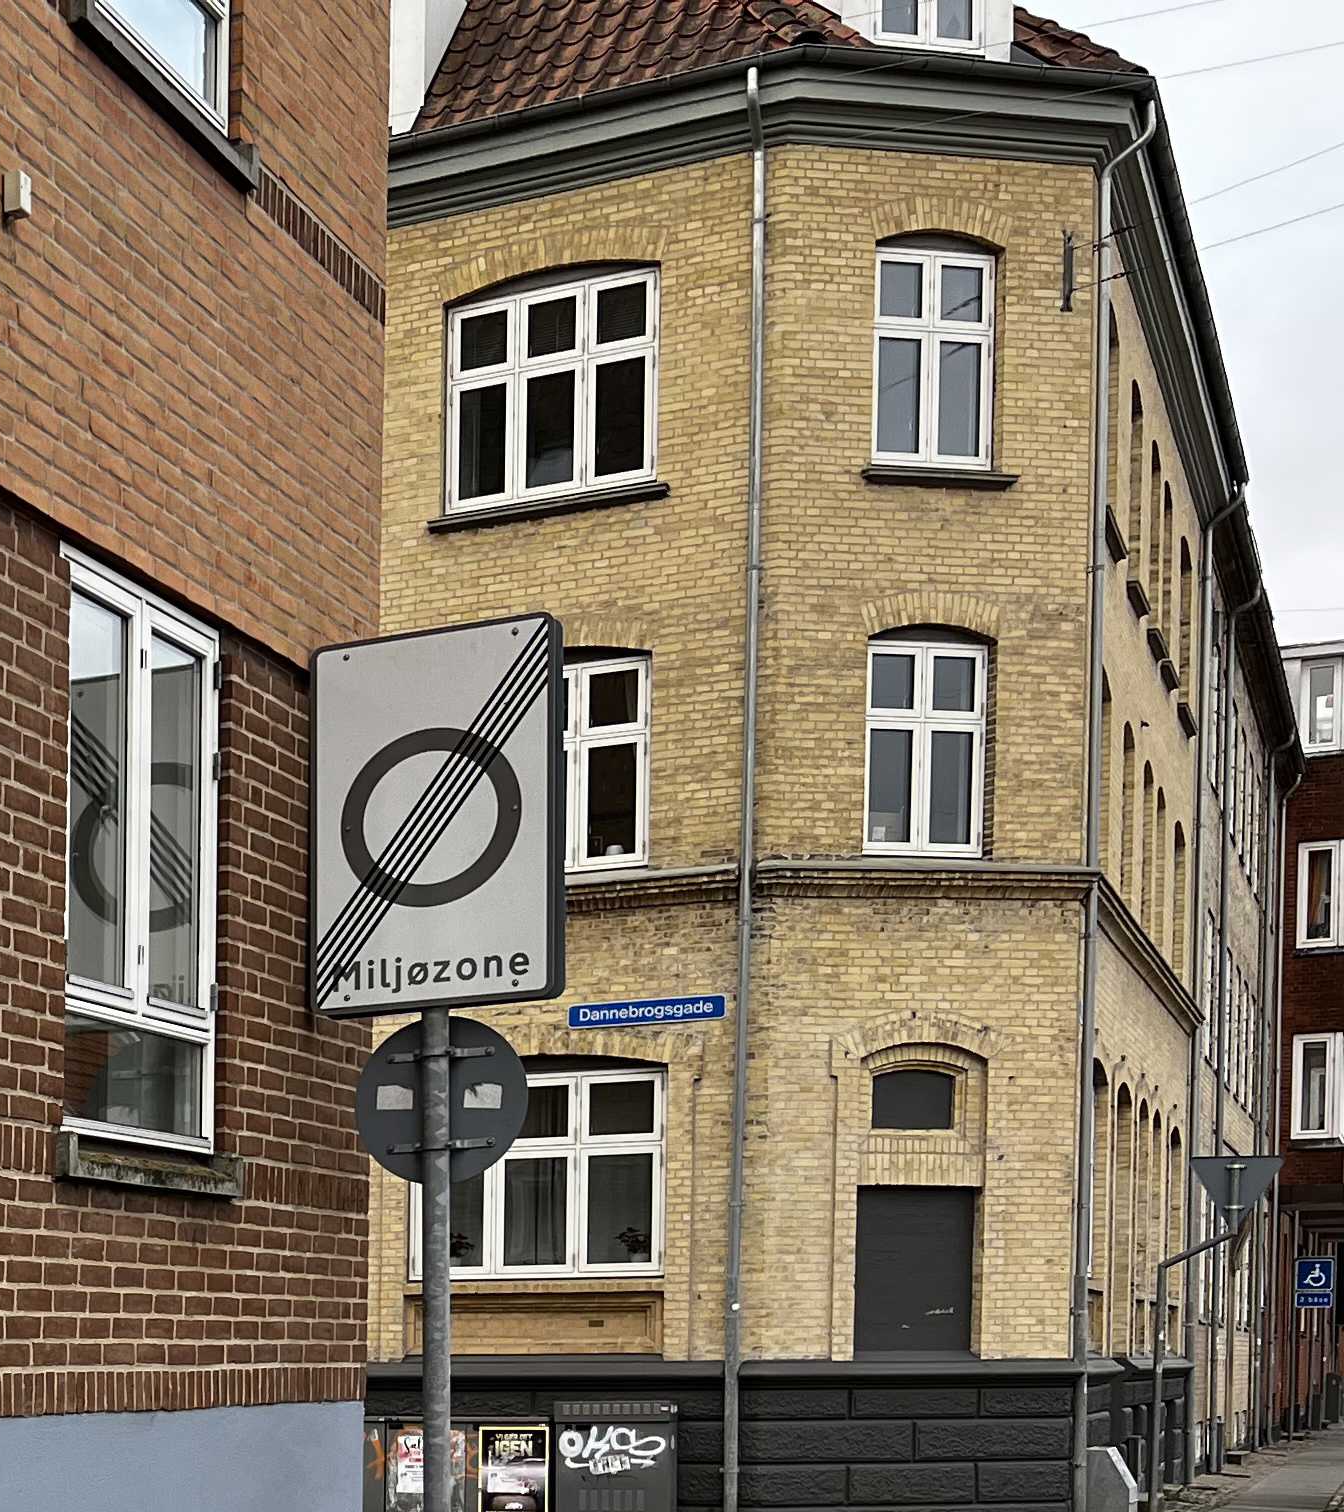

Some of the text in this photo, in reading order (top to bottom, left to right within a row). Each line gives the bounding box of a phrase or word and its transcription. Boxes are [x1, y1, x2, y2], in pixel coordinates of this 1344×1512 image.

[332, 952, 530, 994] Miljøzone
[579, 1000, 713, 1022] Dannebrogsgade
[494, 1440, 533, 1457] IGEN
